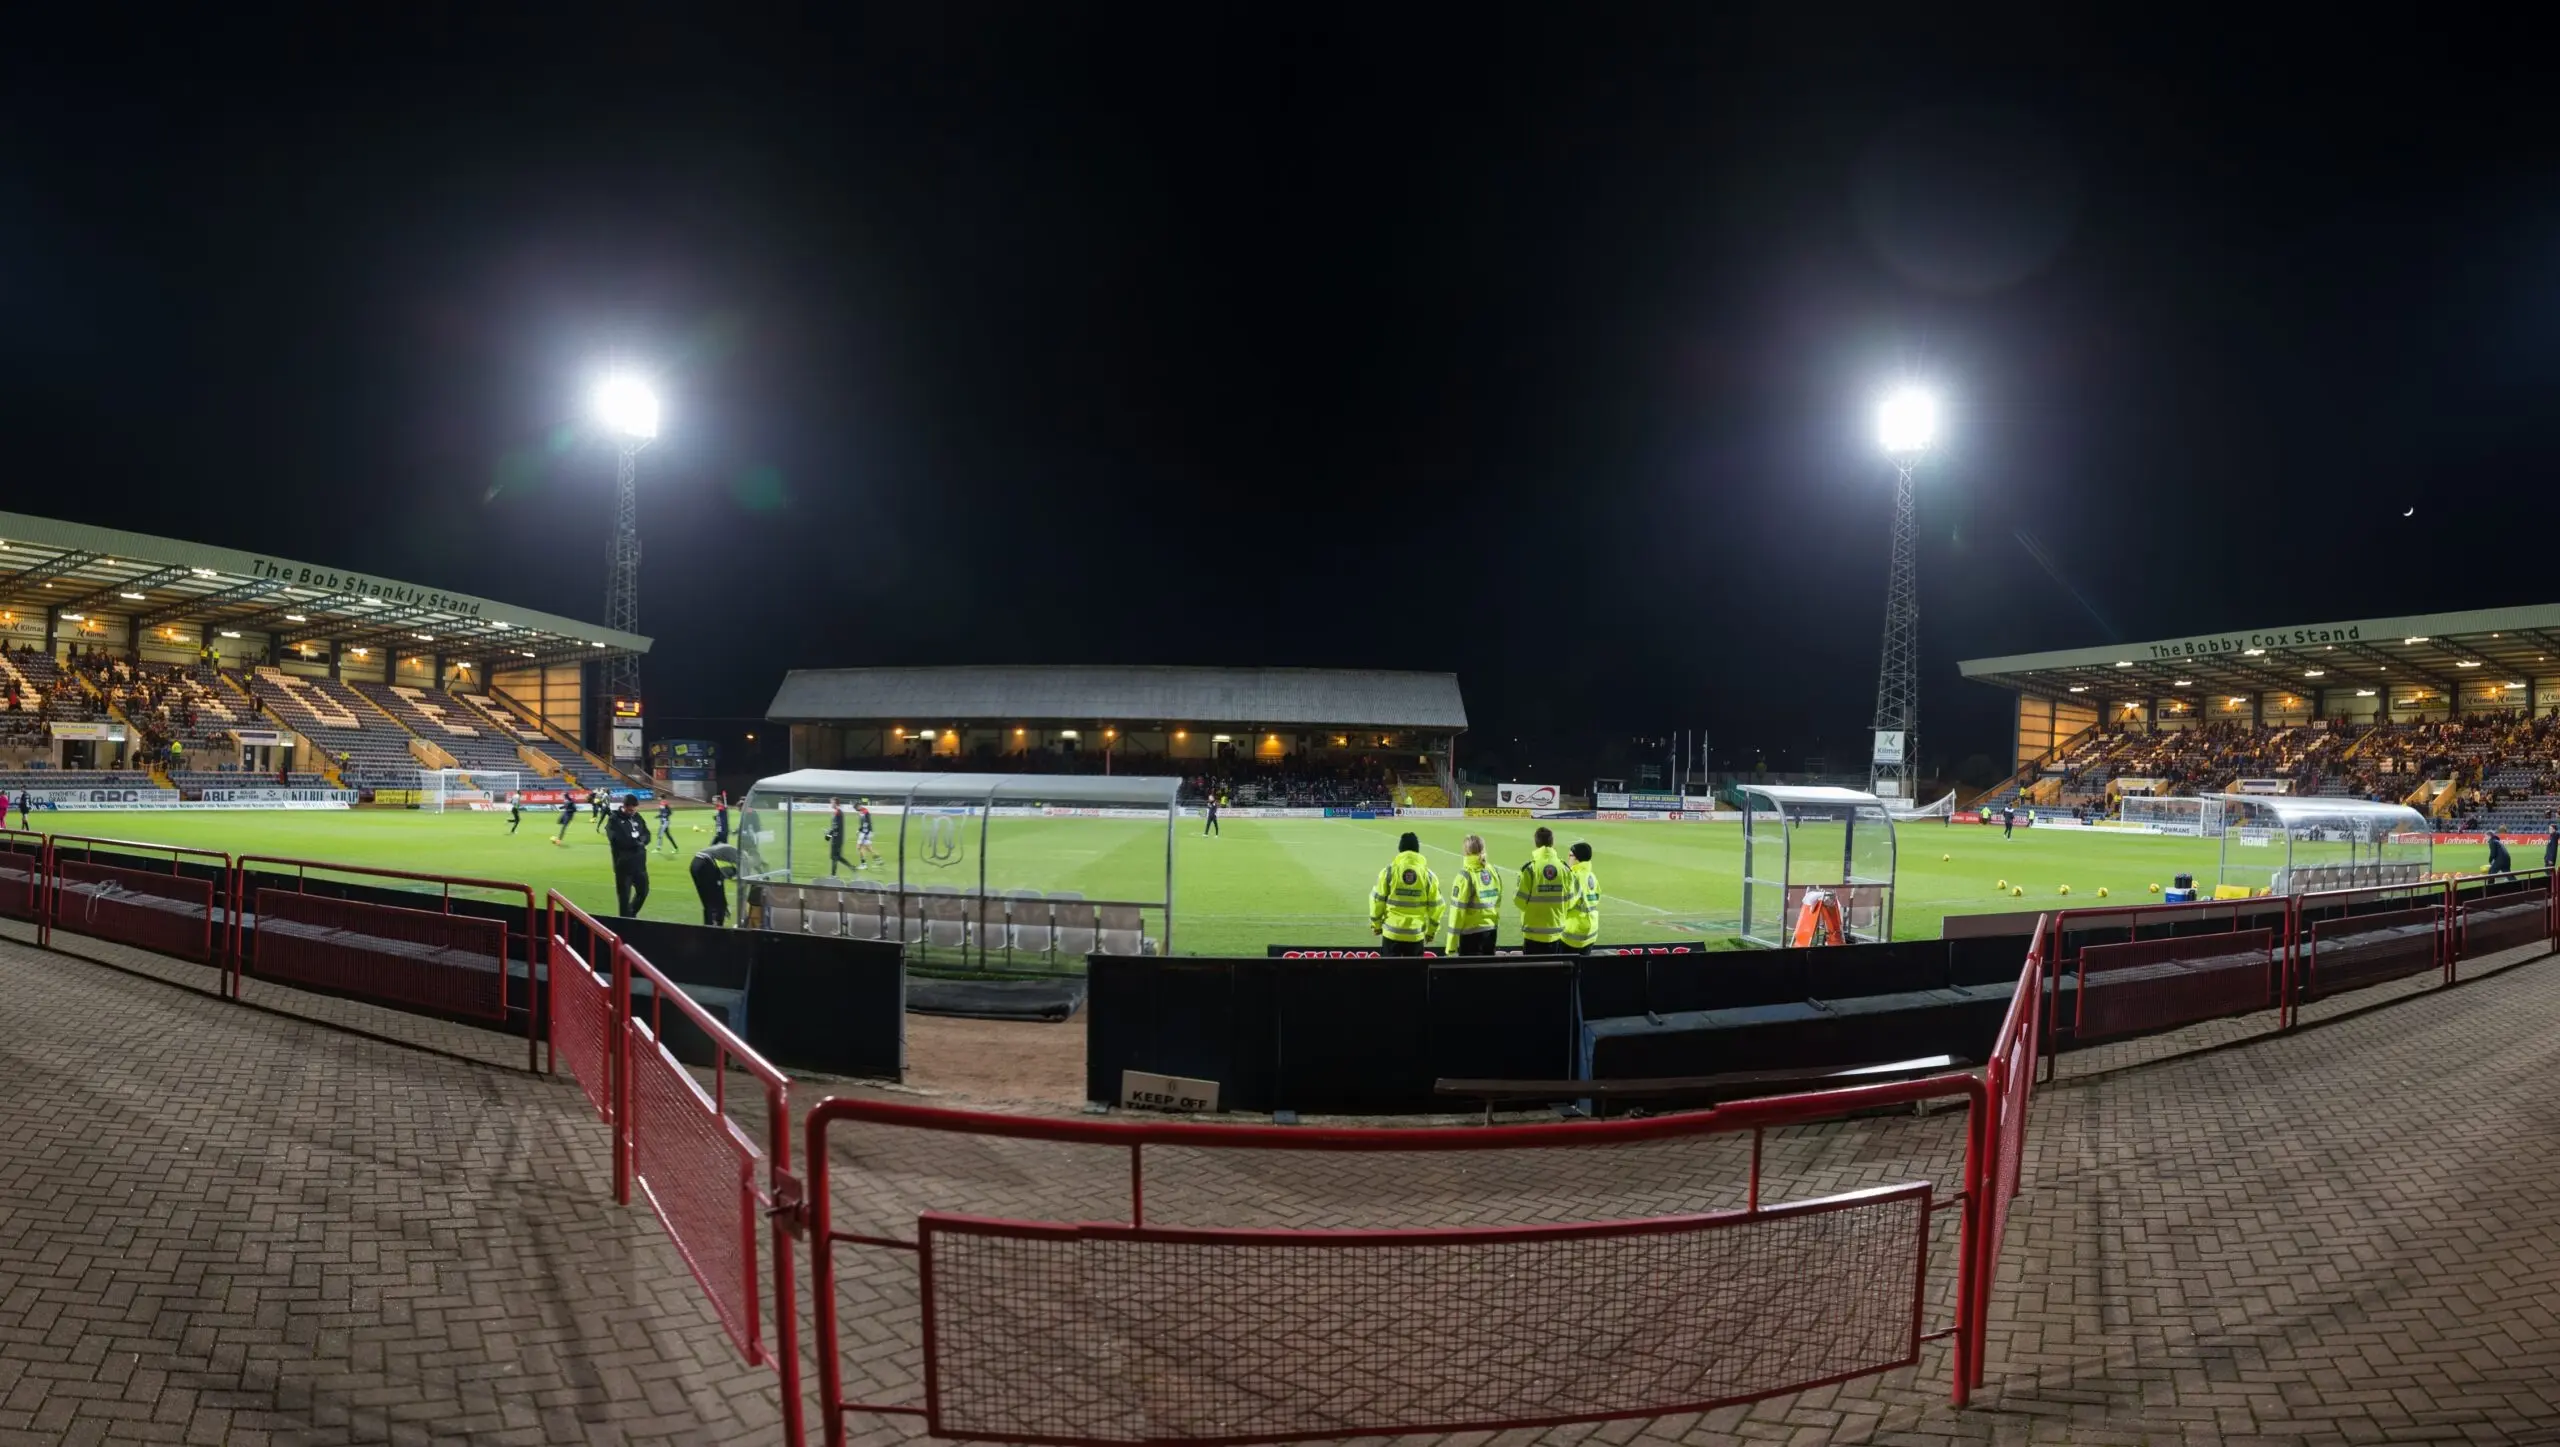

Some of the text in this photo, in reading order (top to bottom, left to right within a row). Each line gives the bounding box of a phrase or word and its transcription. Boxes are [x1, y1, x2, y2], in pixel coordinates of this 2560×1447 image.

[252, 559, 481, 615] The Bob Shankly Stand
[20, 623, 45, 632] Kilmac
[85, 629, 109, 639] Kilmac
[2150, 626, 2360, 659] The Bobby Cox Stand
[203, 790, 236, 802] ABLE
[1598, 812, 1628, 820] swinton
[1132, 1090, 1208, 1109] KEEP OFF
